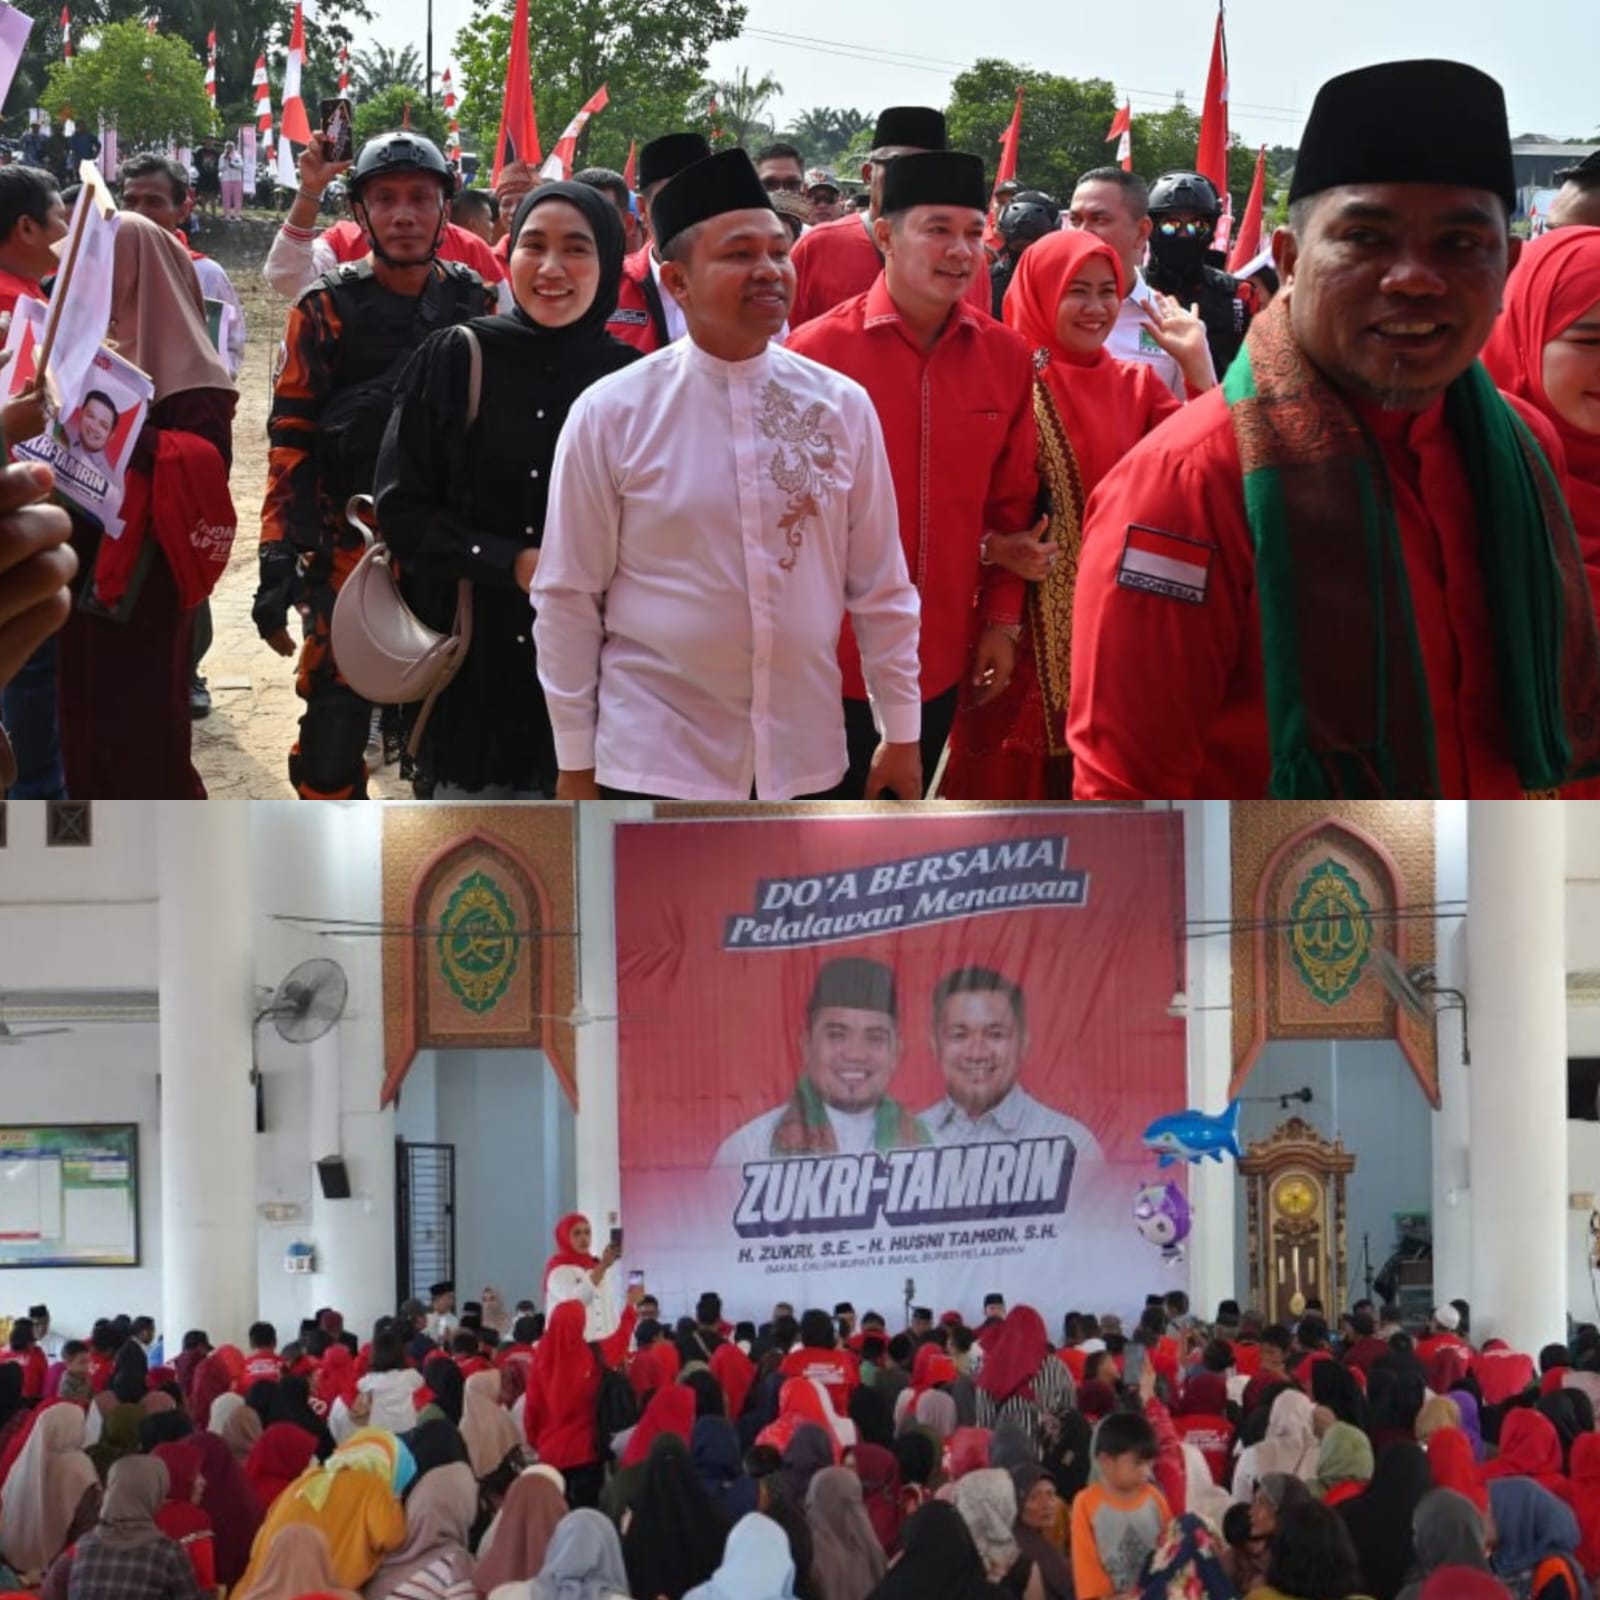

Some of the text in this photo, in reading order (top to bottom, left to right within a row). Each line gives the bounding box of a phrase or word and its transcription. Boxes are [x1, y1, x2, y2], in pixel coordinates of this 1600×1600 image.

[1123, 573, 1200, 601] INDONESIA
[866, 840, 1054, 897] BERSAMA
[729, 880, 1079, 944] Pelalawan Menawan
[735, 1137, 1067, 1226] ZUKRI-TAMRIN
[738, 1247, 755, 1264] H.
[820, 1239, 852, 1256] S.E.
[869, 1237, 885, 1253] H.
[890, 1231, 946, 1251] HUSNI
[1023, 1223, 1058, 1241] S.H.
